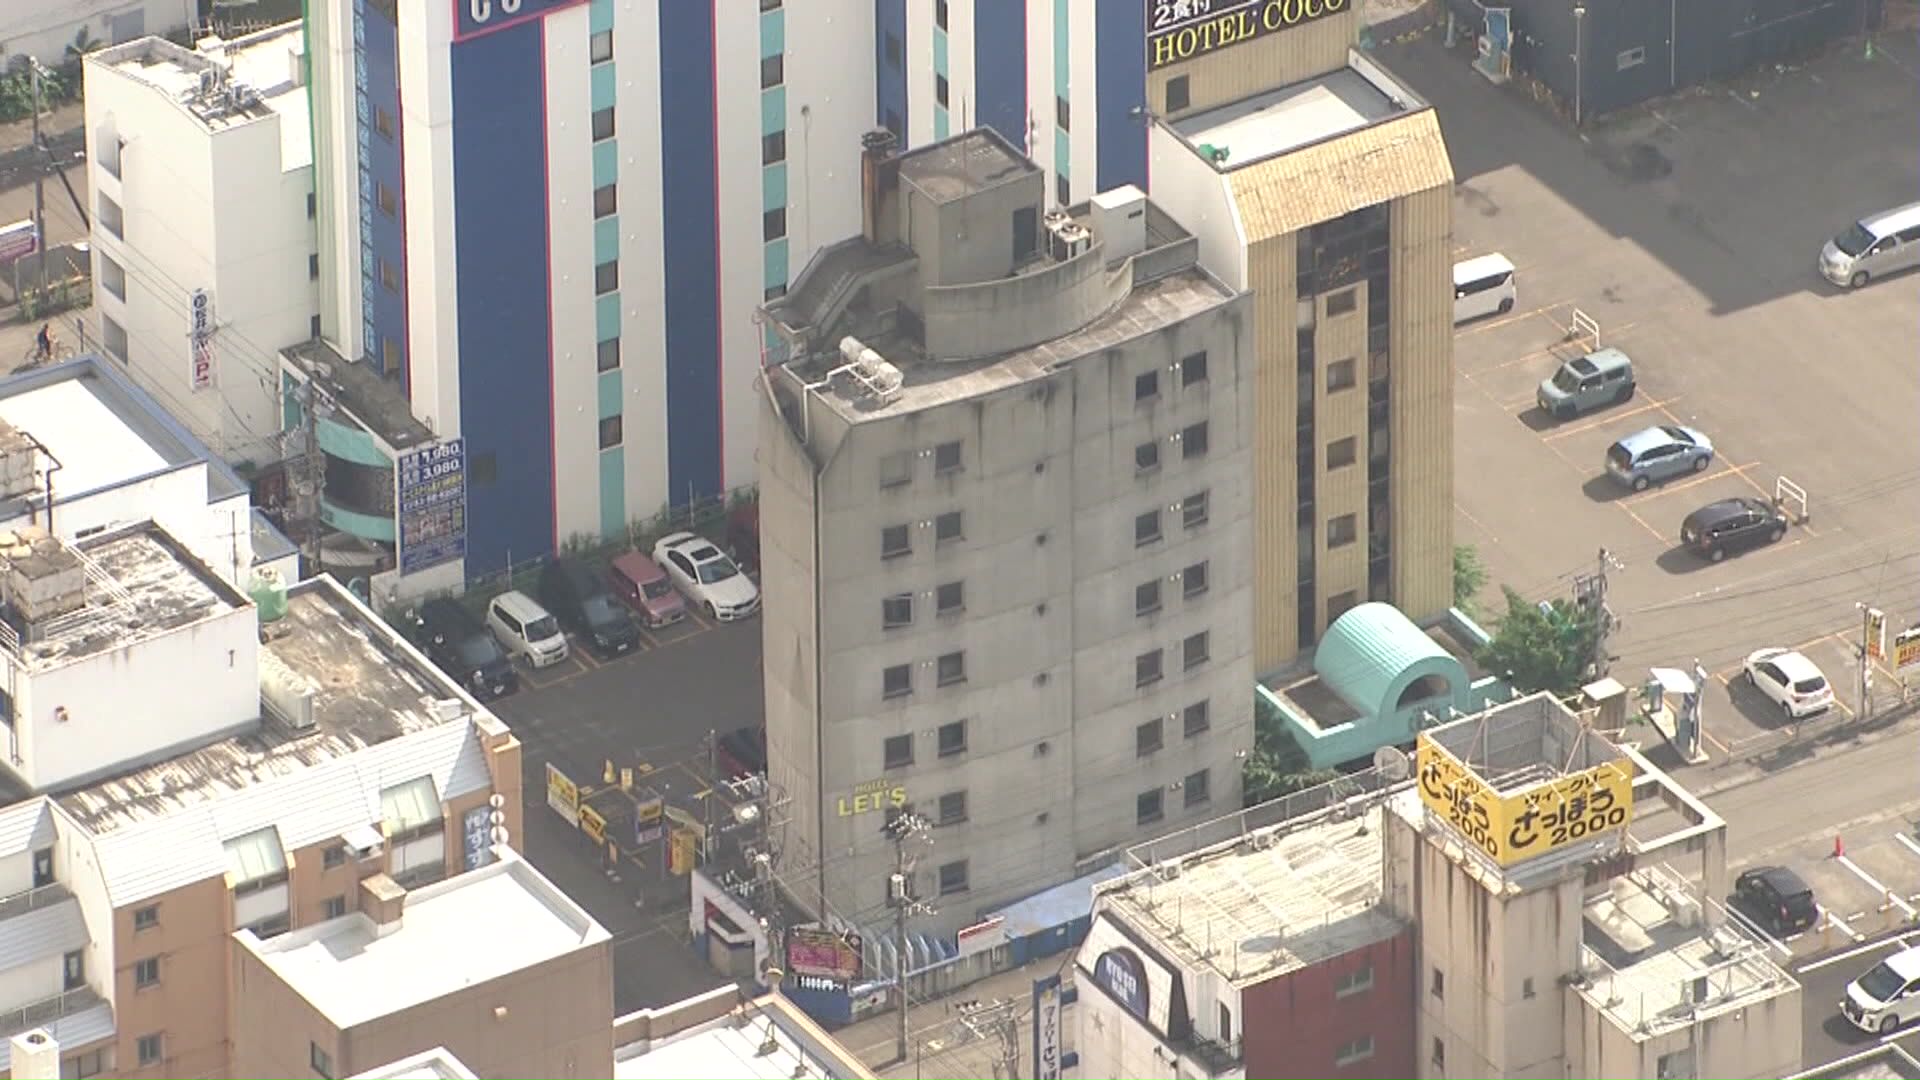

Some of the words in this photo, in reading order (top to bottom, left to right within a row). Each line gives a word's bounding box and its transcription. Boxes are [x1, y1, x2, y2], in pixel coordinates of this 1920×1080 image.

[1153, 11, 1256, 66] HOTEL
[837, 786, 907, 817] LET'S
[1509, 787, 1615, 849] さっぽろ
[1450, 807, 1498, 857] 2000
[1550, 807, 1626, 847] 2000
